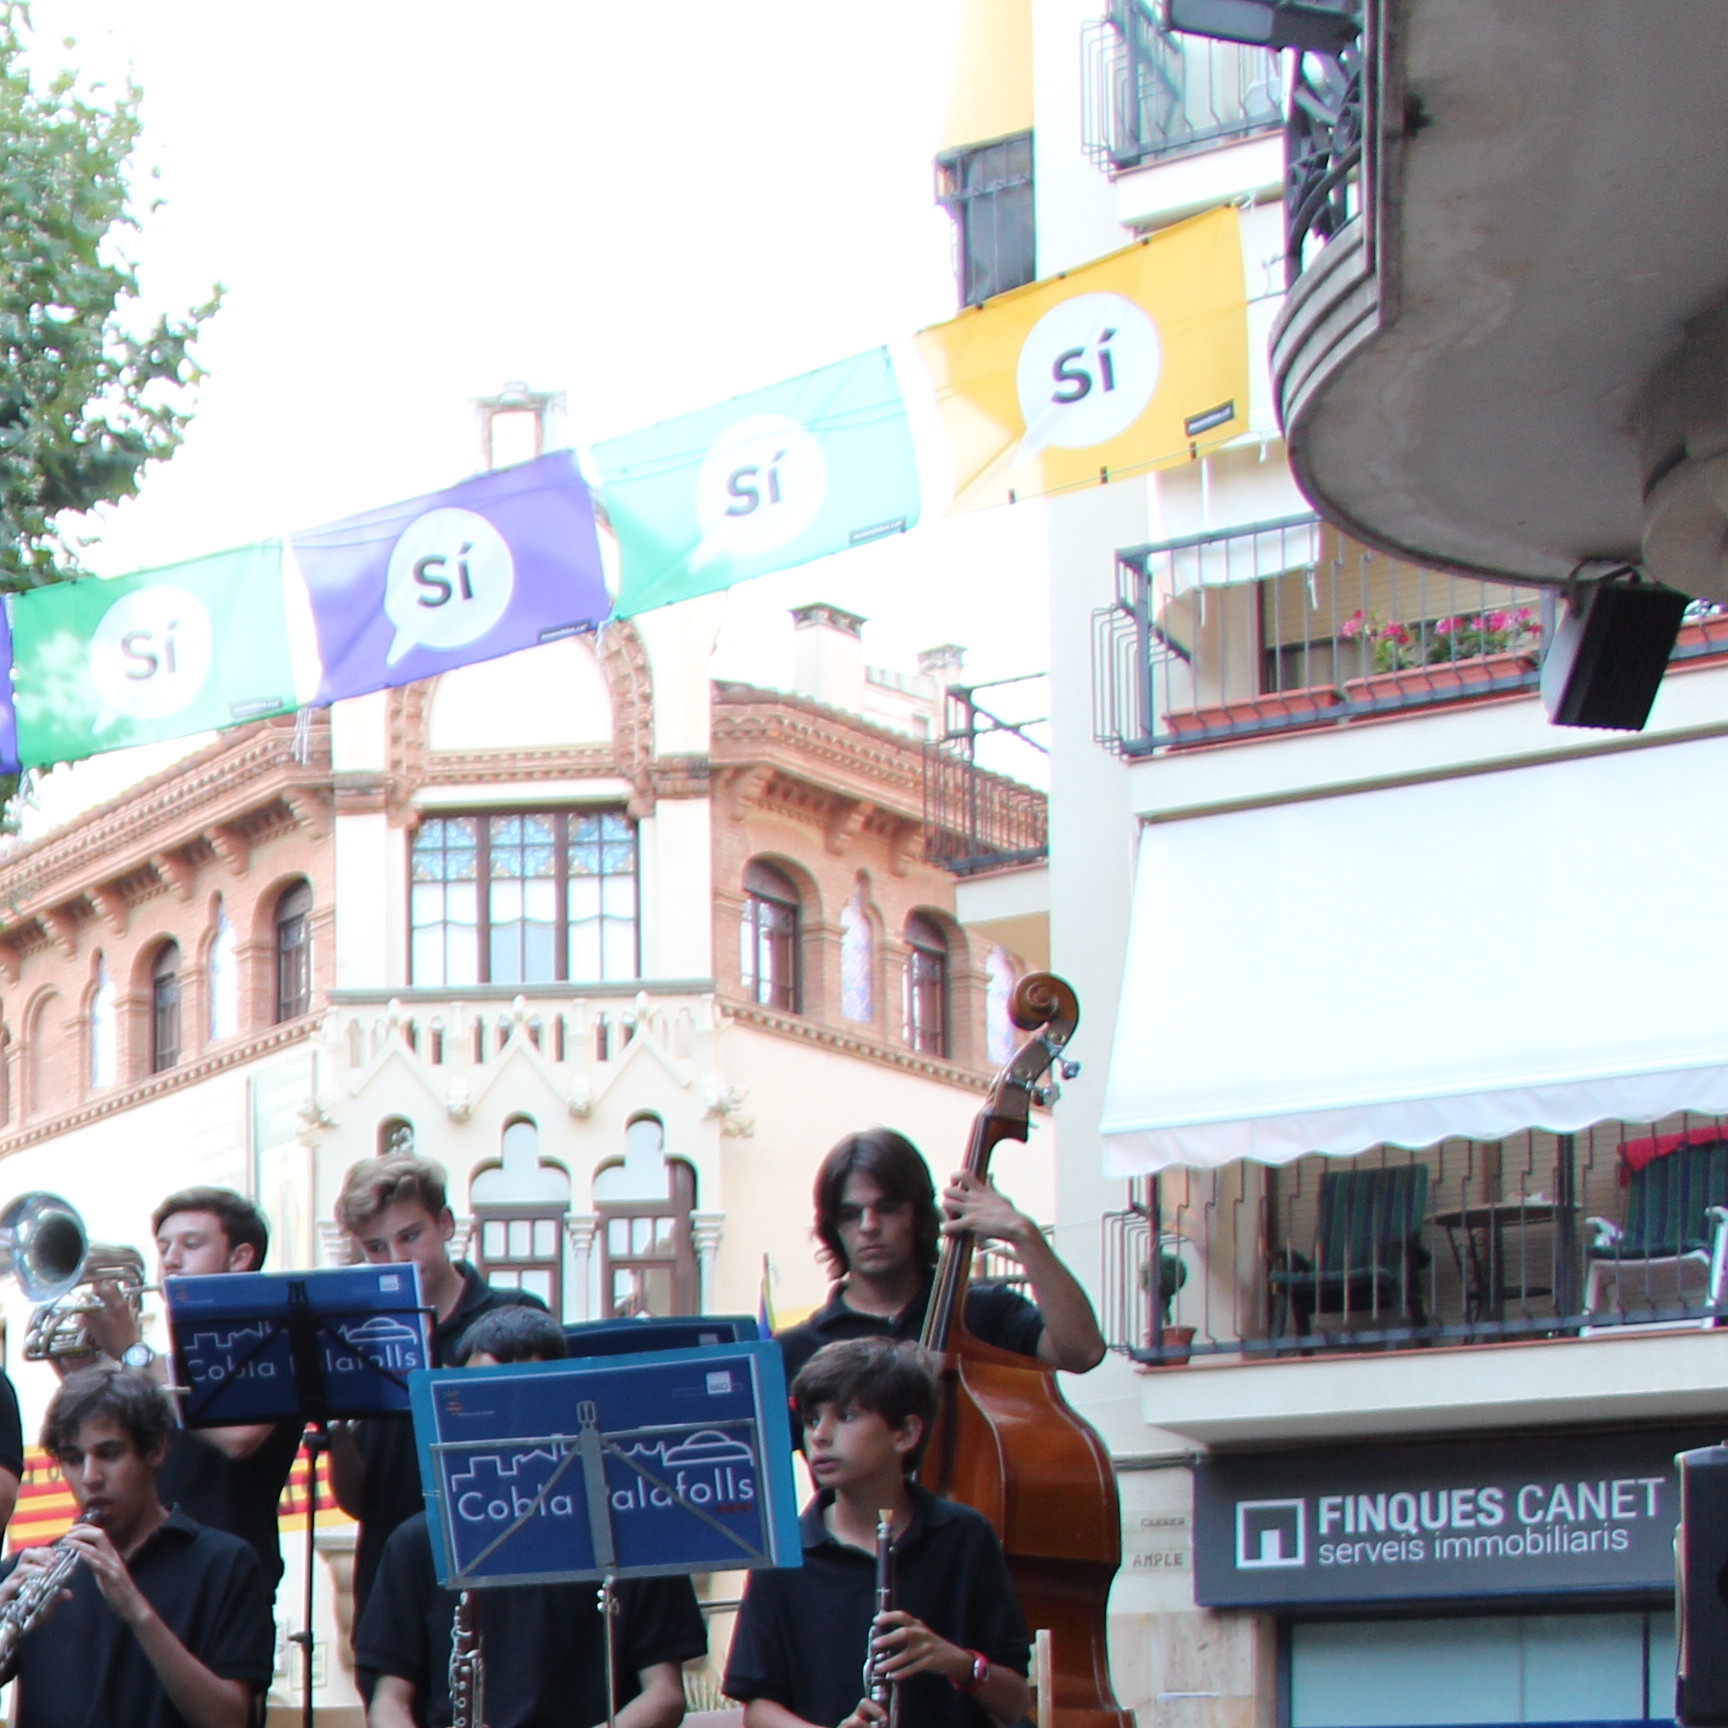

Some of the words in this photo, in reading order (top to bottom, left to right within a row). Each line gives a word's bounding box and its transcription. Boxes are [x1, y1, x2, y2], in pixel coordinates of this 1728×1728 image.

[1049, 326, 1119, 406] Sí
[724, 448, 788, 517] Sí
[411, 541, 475, 609] Sí
[119, 619, 181, 680] Sí
[458, 1484, 573, 1521] Cobla
[612, 1466, 754, 1510] alafolls
[1318, 1487, 1504, 1535] FINQUES
[1517, 1477, 1666, 1523] CANET
[1132, 1552, 1184, 1568] AMPLE
[1318, 1533, 1424, 1565] serveis
[1435, 1523, 1629, 1559] immobiliaris
